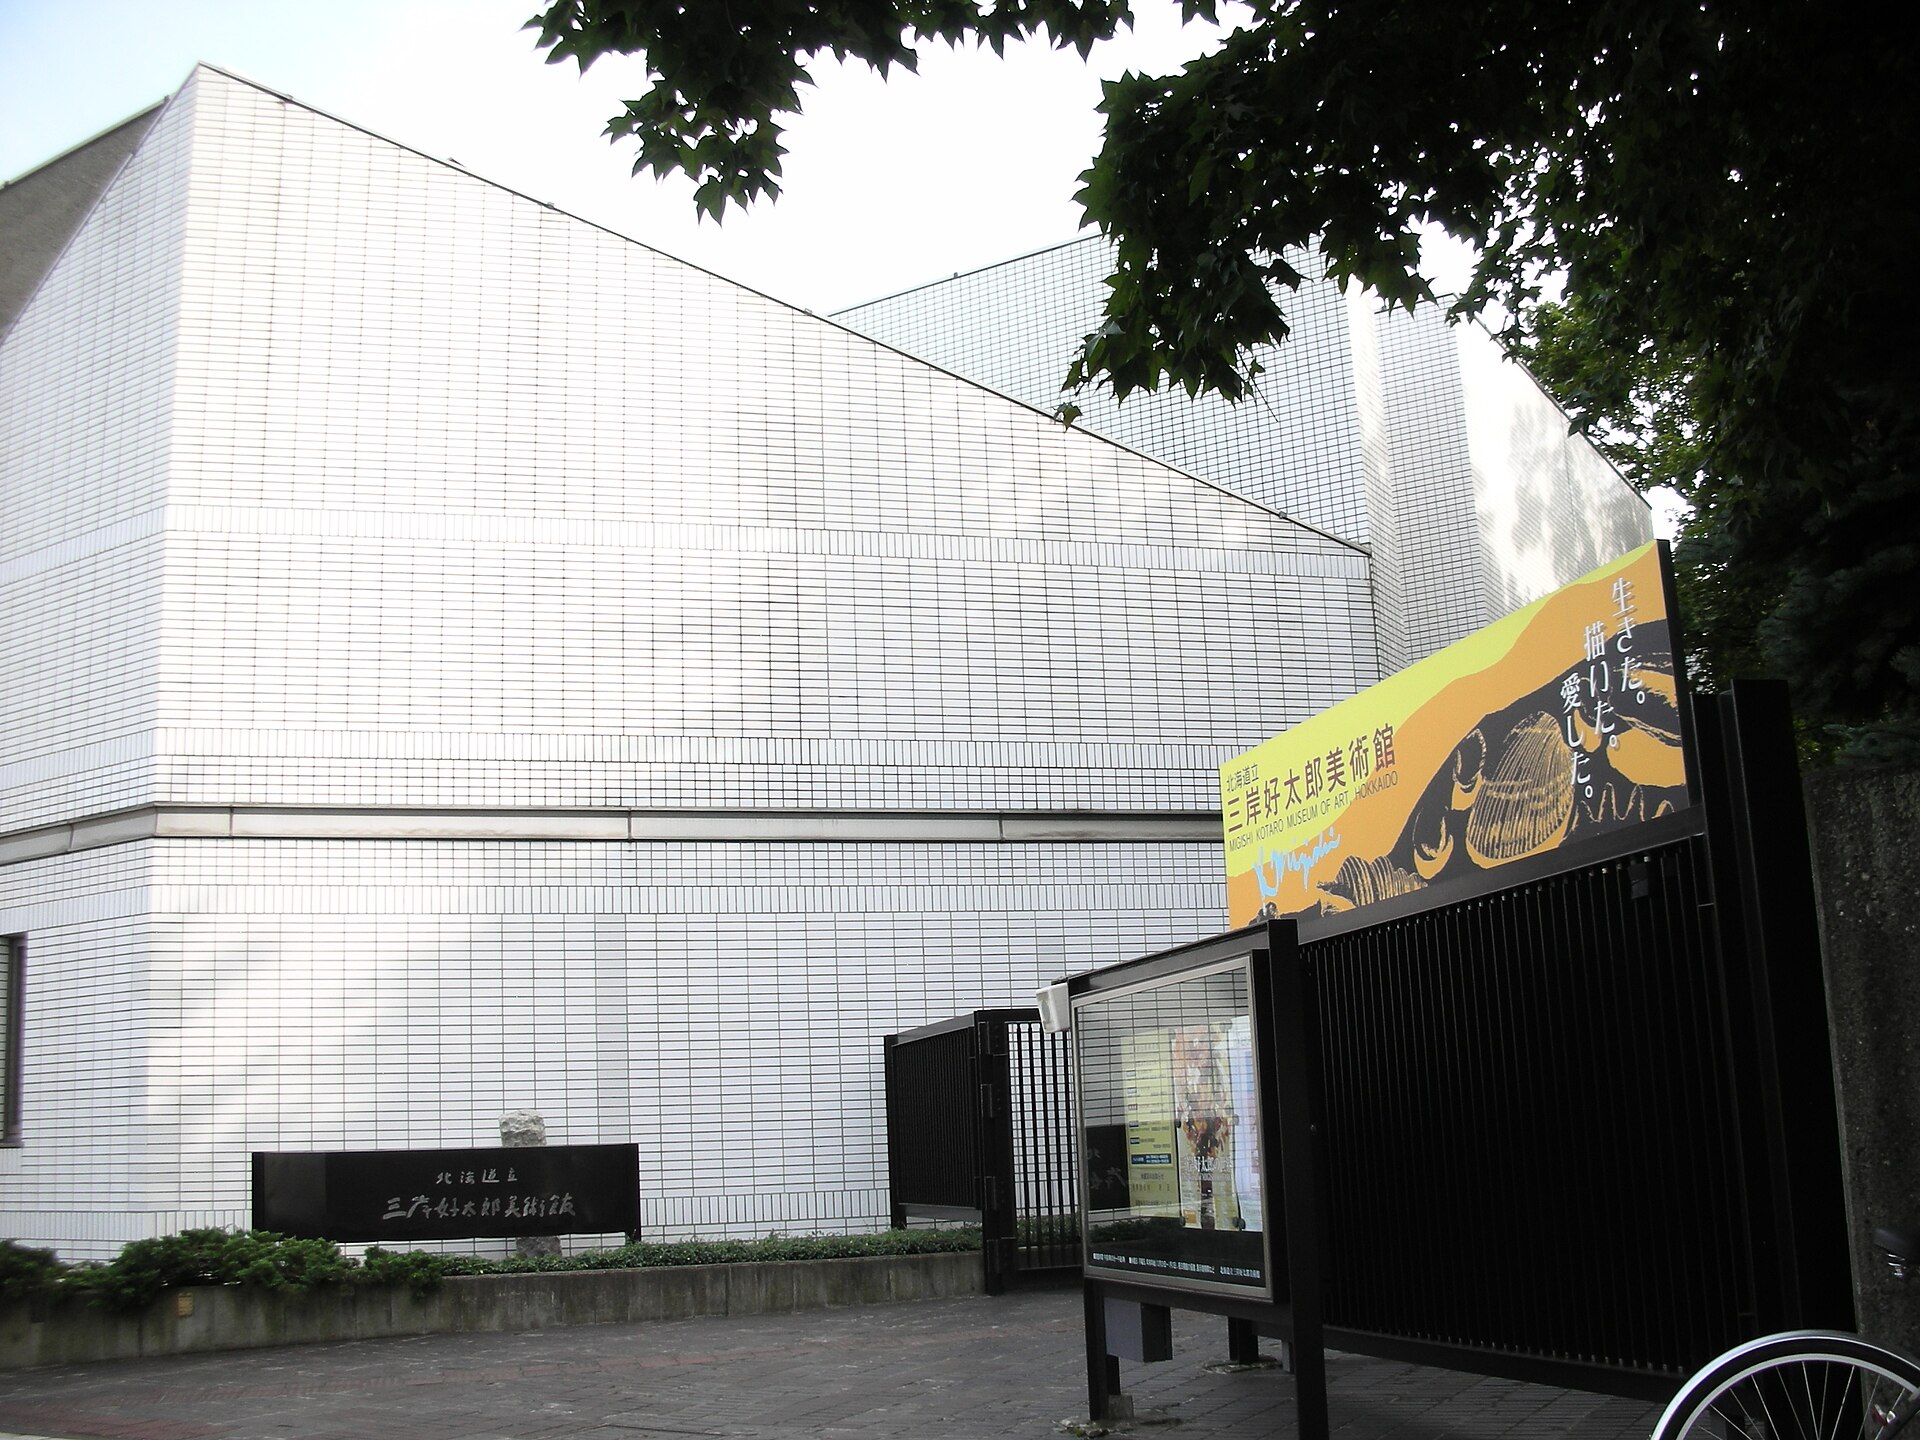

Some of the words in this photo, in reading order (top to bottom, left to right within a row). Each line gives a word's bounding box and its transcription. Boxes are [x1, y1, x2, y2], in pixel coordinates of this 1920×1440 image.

[1584, 620, 1618, 748] 描いた。
[1611, 577, 1646, 705] 生きた。
[1226, 764, 1258, 792] 北海道立
[1228, 723, 1396, 833] 三岸好太郎美術館
[1560, 672, 1594, 799] 愛した。
[1229, 831, 1254, 852] MIGISHI
[1256, 818, 1284, 842] KOTARO
[1286, 807, 1318, 828] MUSEUM
[1320, 799, 1332, 815] OF
[1355, 771, 1399, 801] HOKKAIDO
[435, 1167, 518, 1185] 北海道立
